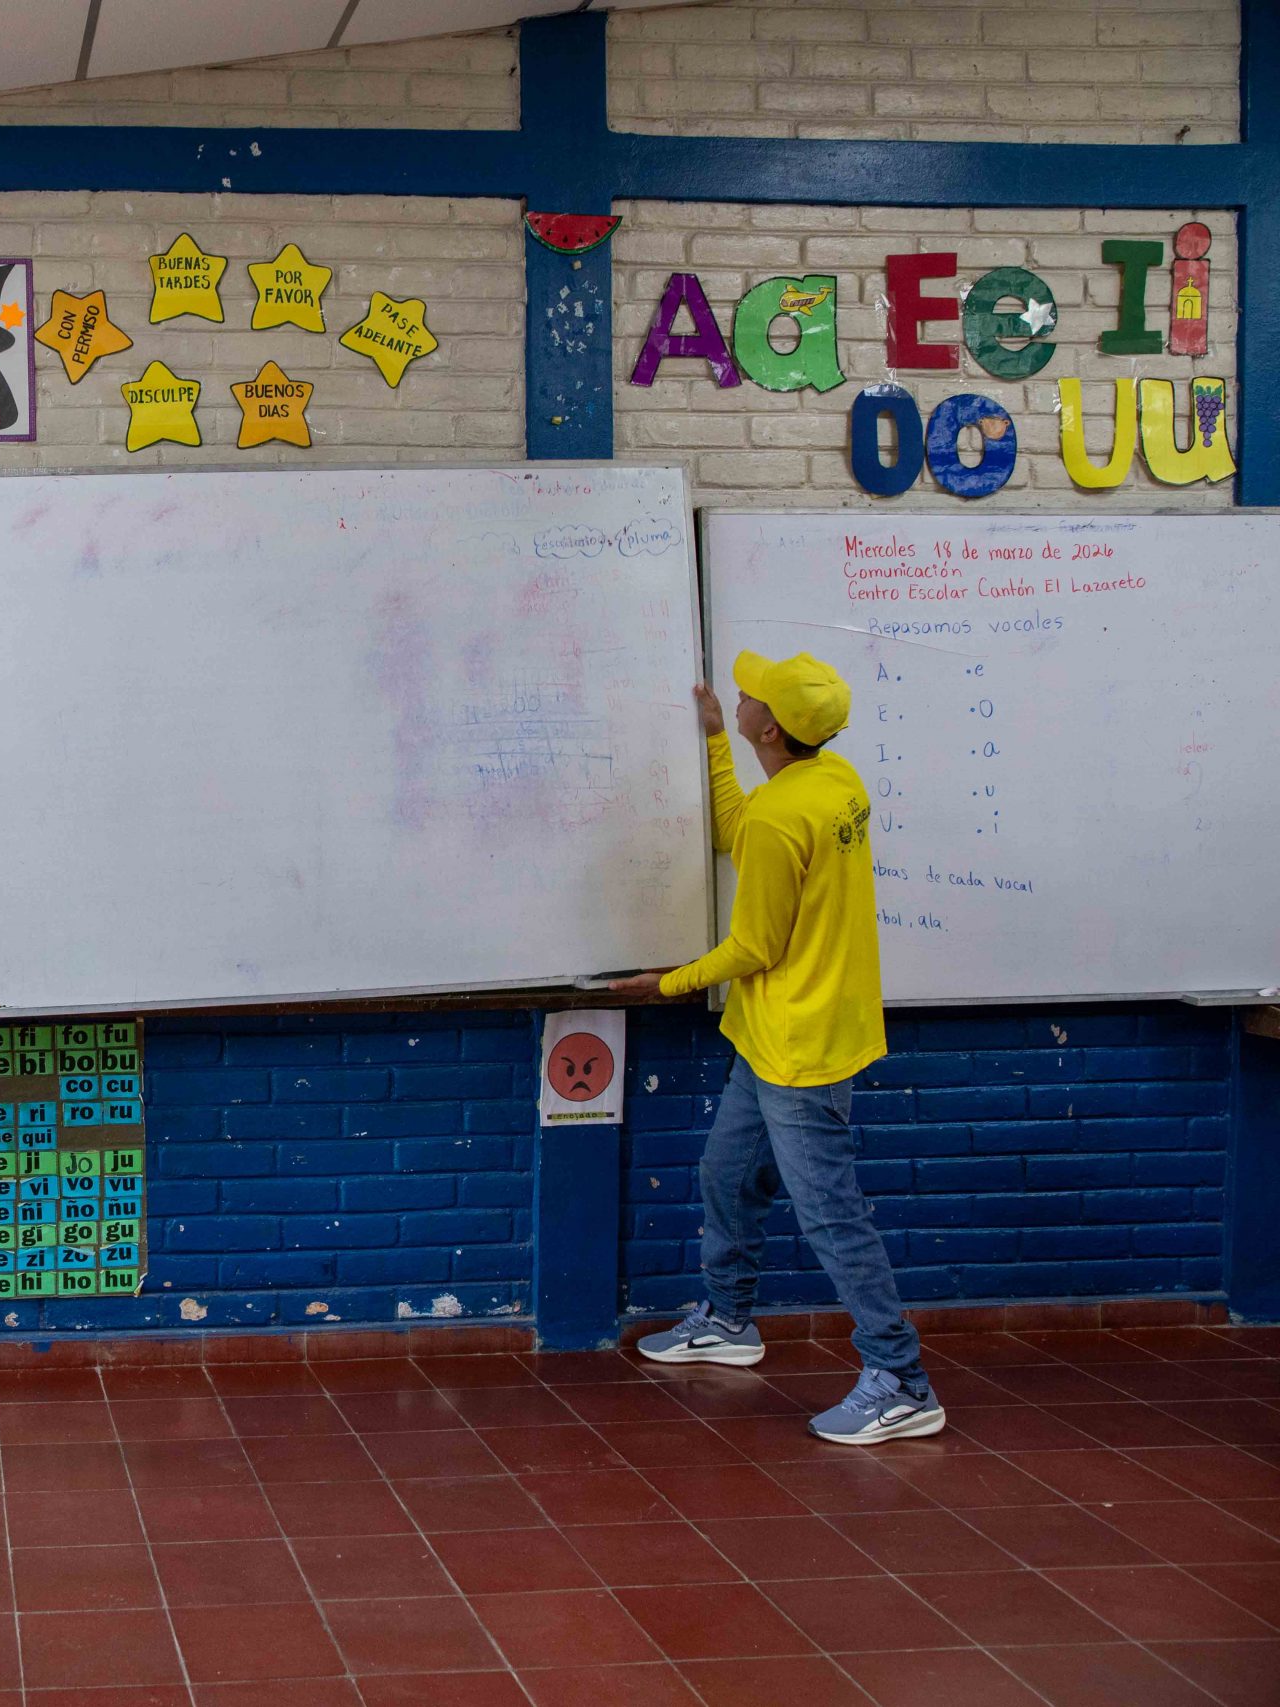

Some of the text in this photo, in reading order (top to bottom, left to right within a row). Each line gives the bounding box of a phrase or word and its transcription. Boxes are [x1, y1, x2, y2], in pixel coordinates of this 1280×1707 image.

[159, 257, 210, 270] BUENAS
[159, 276, 210, 289] TARDES
[276, 270, 302, 285] POR
[265, 289, 313, 307] FAVOR
[58, 311, 77, 339] CON
[381, 303, 419, 338] PASE
[72, 306, 100, 364] PERMISO
[354, 325, 421, 357] ADELANTE
[129, 387, 194, 403] DISCULPE
[245, 384, 304, 398] BUENOS
[259, 404, 289, 418] DIAS
[844, 536, 1113, 561] Miercoles 18 de marzo de 2026
[844, 561, 962, 579] Comunicación
[848, 574, 1145, 601] Centro Escolar Cantón El Lazareto
[868, 609, 1064, 638] Repasamos vocales
[926, 866, 941, 883] de
[949, 872, 984, 888] cada
[994, 876, 1033, 893] vocal
[19, 1028, 35, 1046] fi
[62, 1026, 88, 1044] fo
[103, 1025, 128, 1043] fu
[20, 1053, 46, 1074] bi
[60, 1051, 94, 1072] bo
[102, 1051, 135, 1070] bu
[66, 1078, 92, 1092] co
[106, 1078, 133, 1092] cu
[30, 1104, 45, 1121] ri
[71, 1106, 93, 1120] ro
[110, 1104, 132, 1119] ru
[23, 1129, 52, 1145] qui
[25, 1153, 39, 1173] ji
[113, 1151, 133, 1171] ju
[30, 1178, 48, 1196] vi
[67, 1176, 93, 1191] vo
[110, 1177, 135, 1192] vu
[22, 1203, 42, 1220] ñi
[66, 1201, 94, 1218] ño
[109, 1199, 135, 1217] ñu
[22, 1227, 42, 1246] gi
[64, 1225, 92, 1243] go
[106, 1223, 133, 1241] gu
[27, 1251, 44, 1267] zi
[63, 1248, 88, 1262] zo
[107, 1246, 131, 1261] zu
[22, 1273, 41, 1290] hi
[63, 1273, 91, 1289] ho
[105, 1271, 132, 1287] hu
